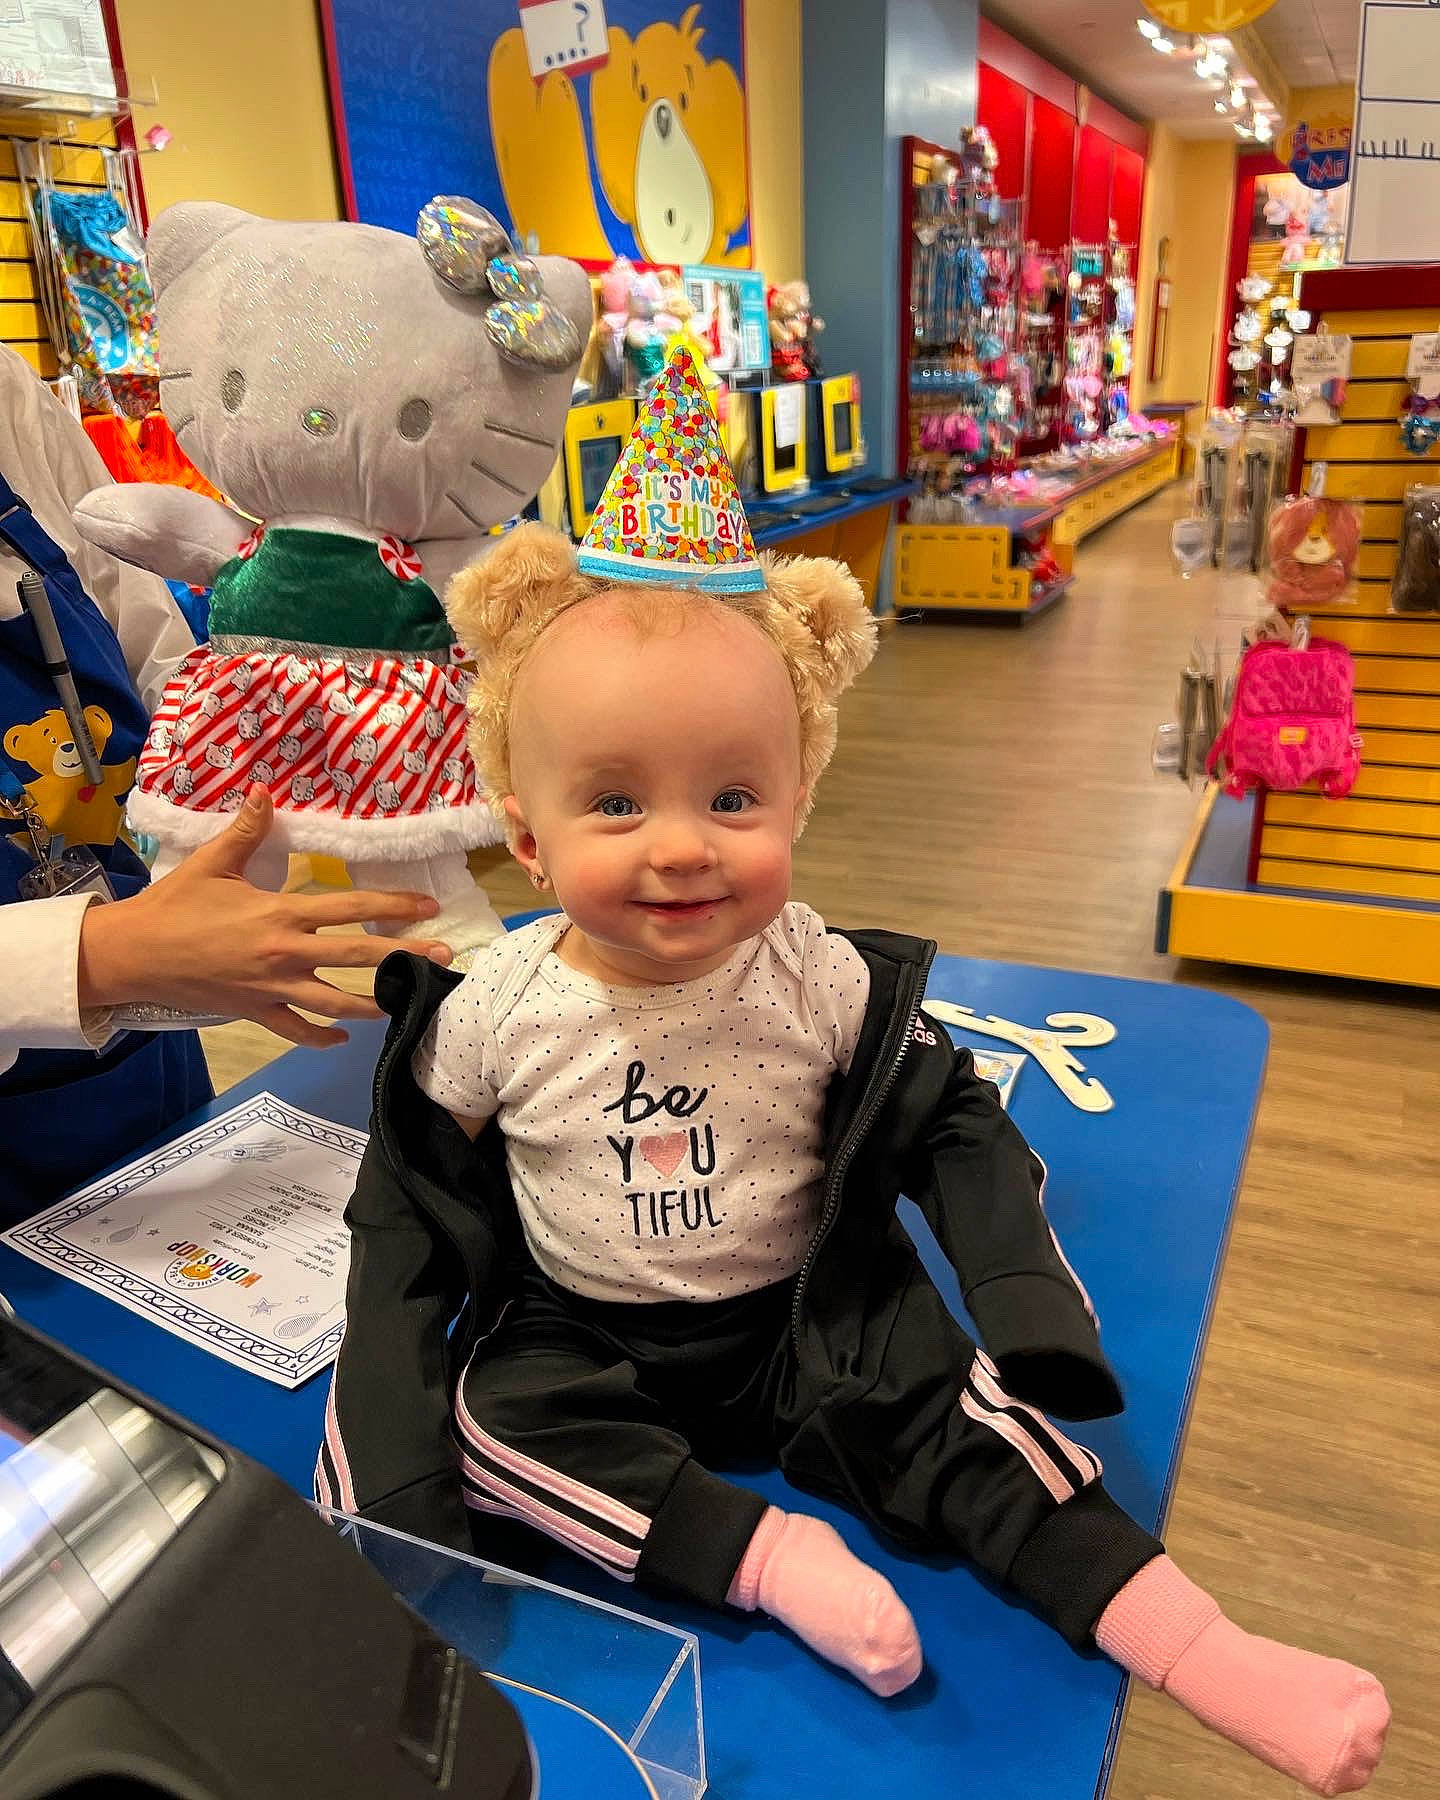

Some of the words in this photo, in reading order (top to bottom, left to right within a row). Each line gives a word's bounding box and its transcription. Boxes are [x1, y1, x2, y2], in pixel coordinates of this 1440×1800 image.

[603, 1060, 708, 1124] be
[625, 1186, 722, 1236] TIFUL
[166, 1240, 263, 1289] WORKSHOP
